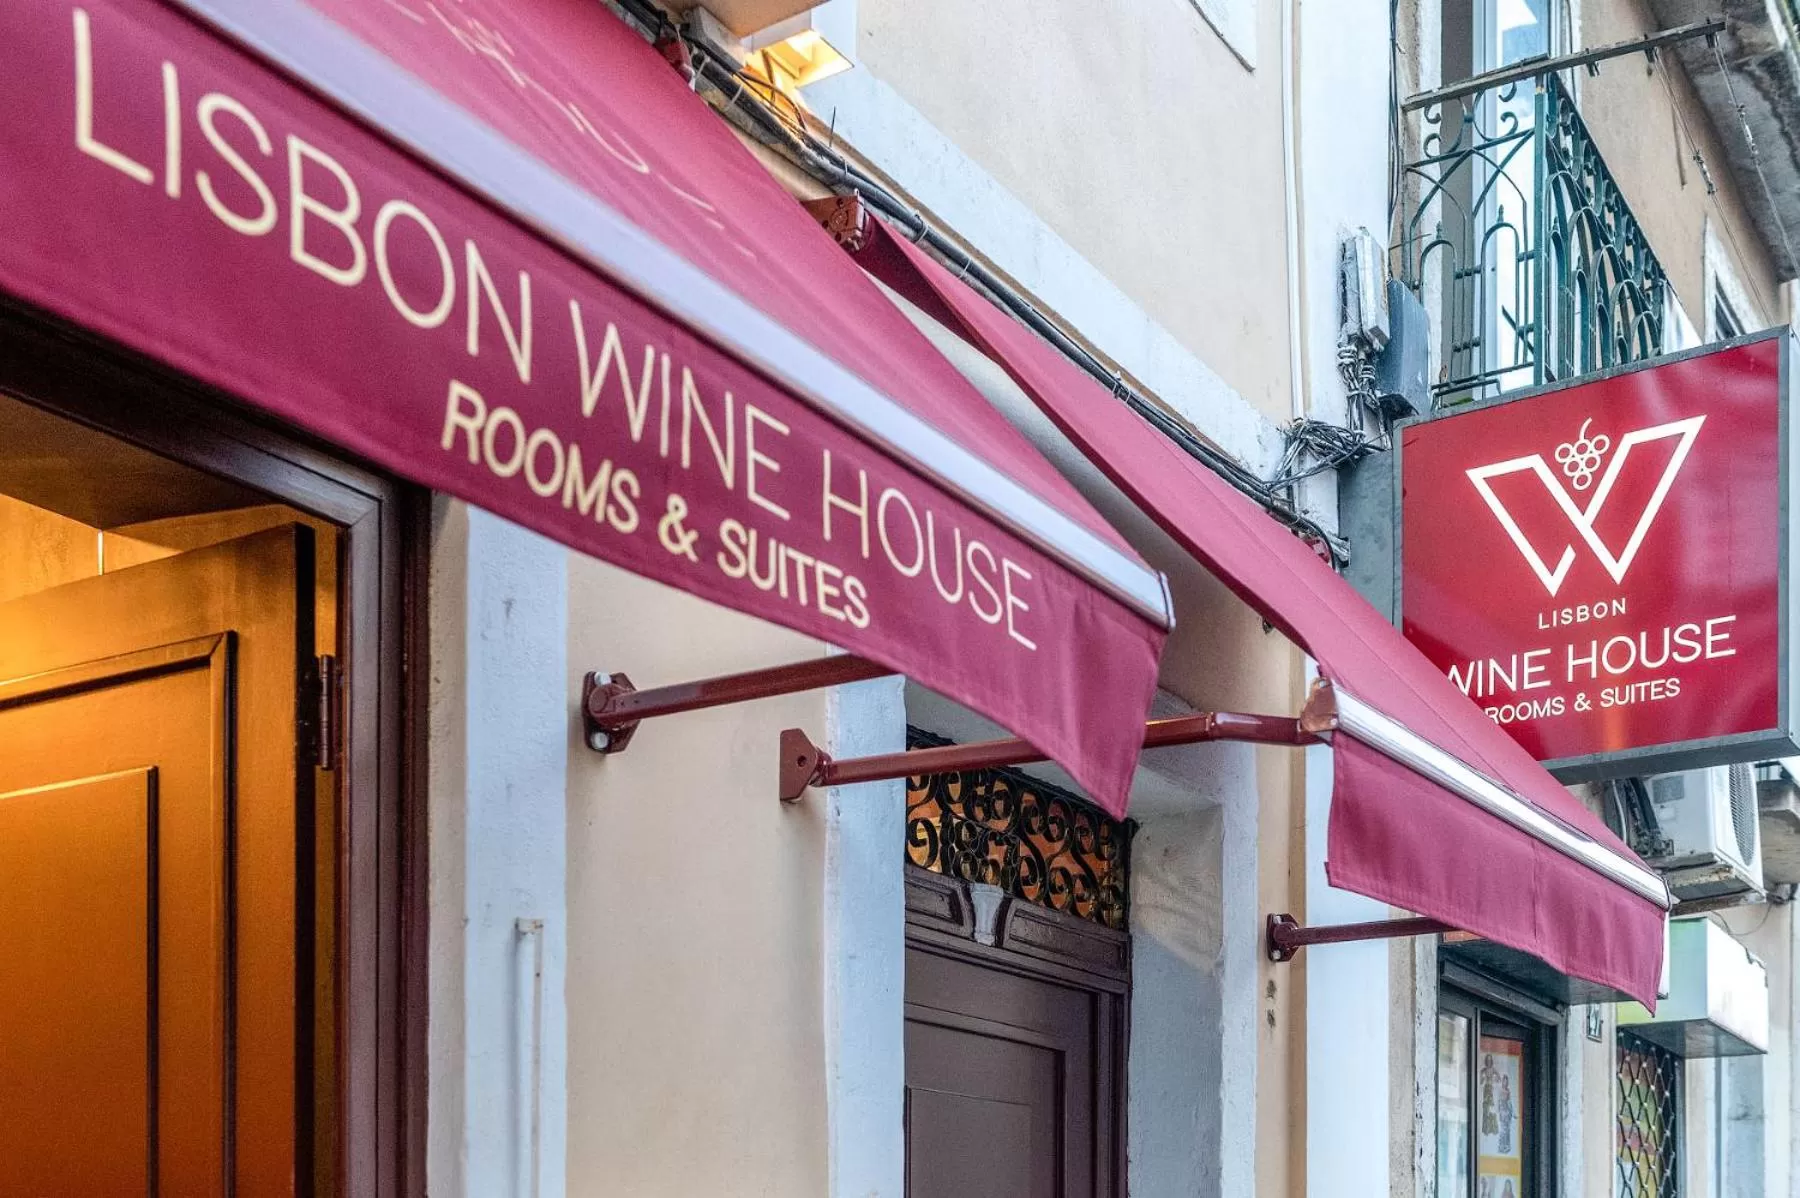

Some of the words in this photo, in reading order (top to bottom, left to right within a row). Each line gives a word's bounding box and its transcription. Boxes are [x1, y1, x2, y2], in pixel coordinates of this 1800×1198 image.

[73, 8, 531, 384] LISBON
[570, 300, 790, 520] WINE
[823, 449, 1037, 650] HOUSE
[441, 379, 641, 534] ROOMS
[658, 493, 699, 563] &
[717, 518, 871, 629] SUITES
[1537, 597, 1627, 630] LISBON
[1567, 614, 1737, 683] HOUSE
[1573, 692, 1593, 712] &
[1600, 677, 1681, 708] SUITES
